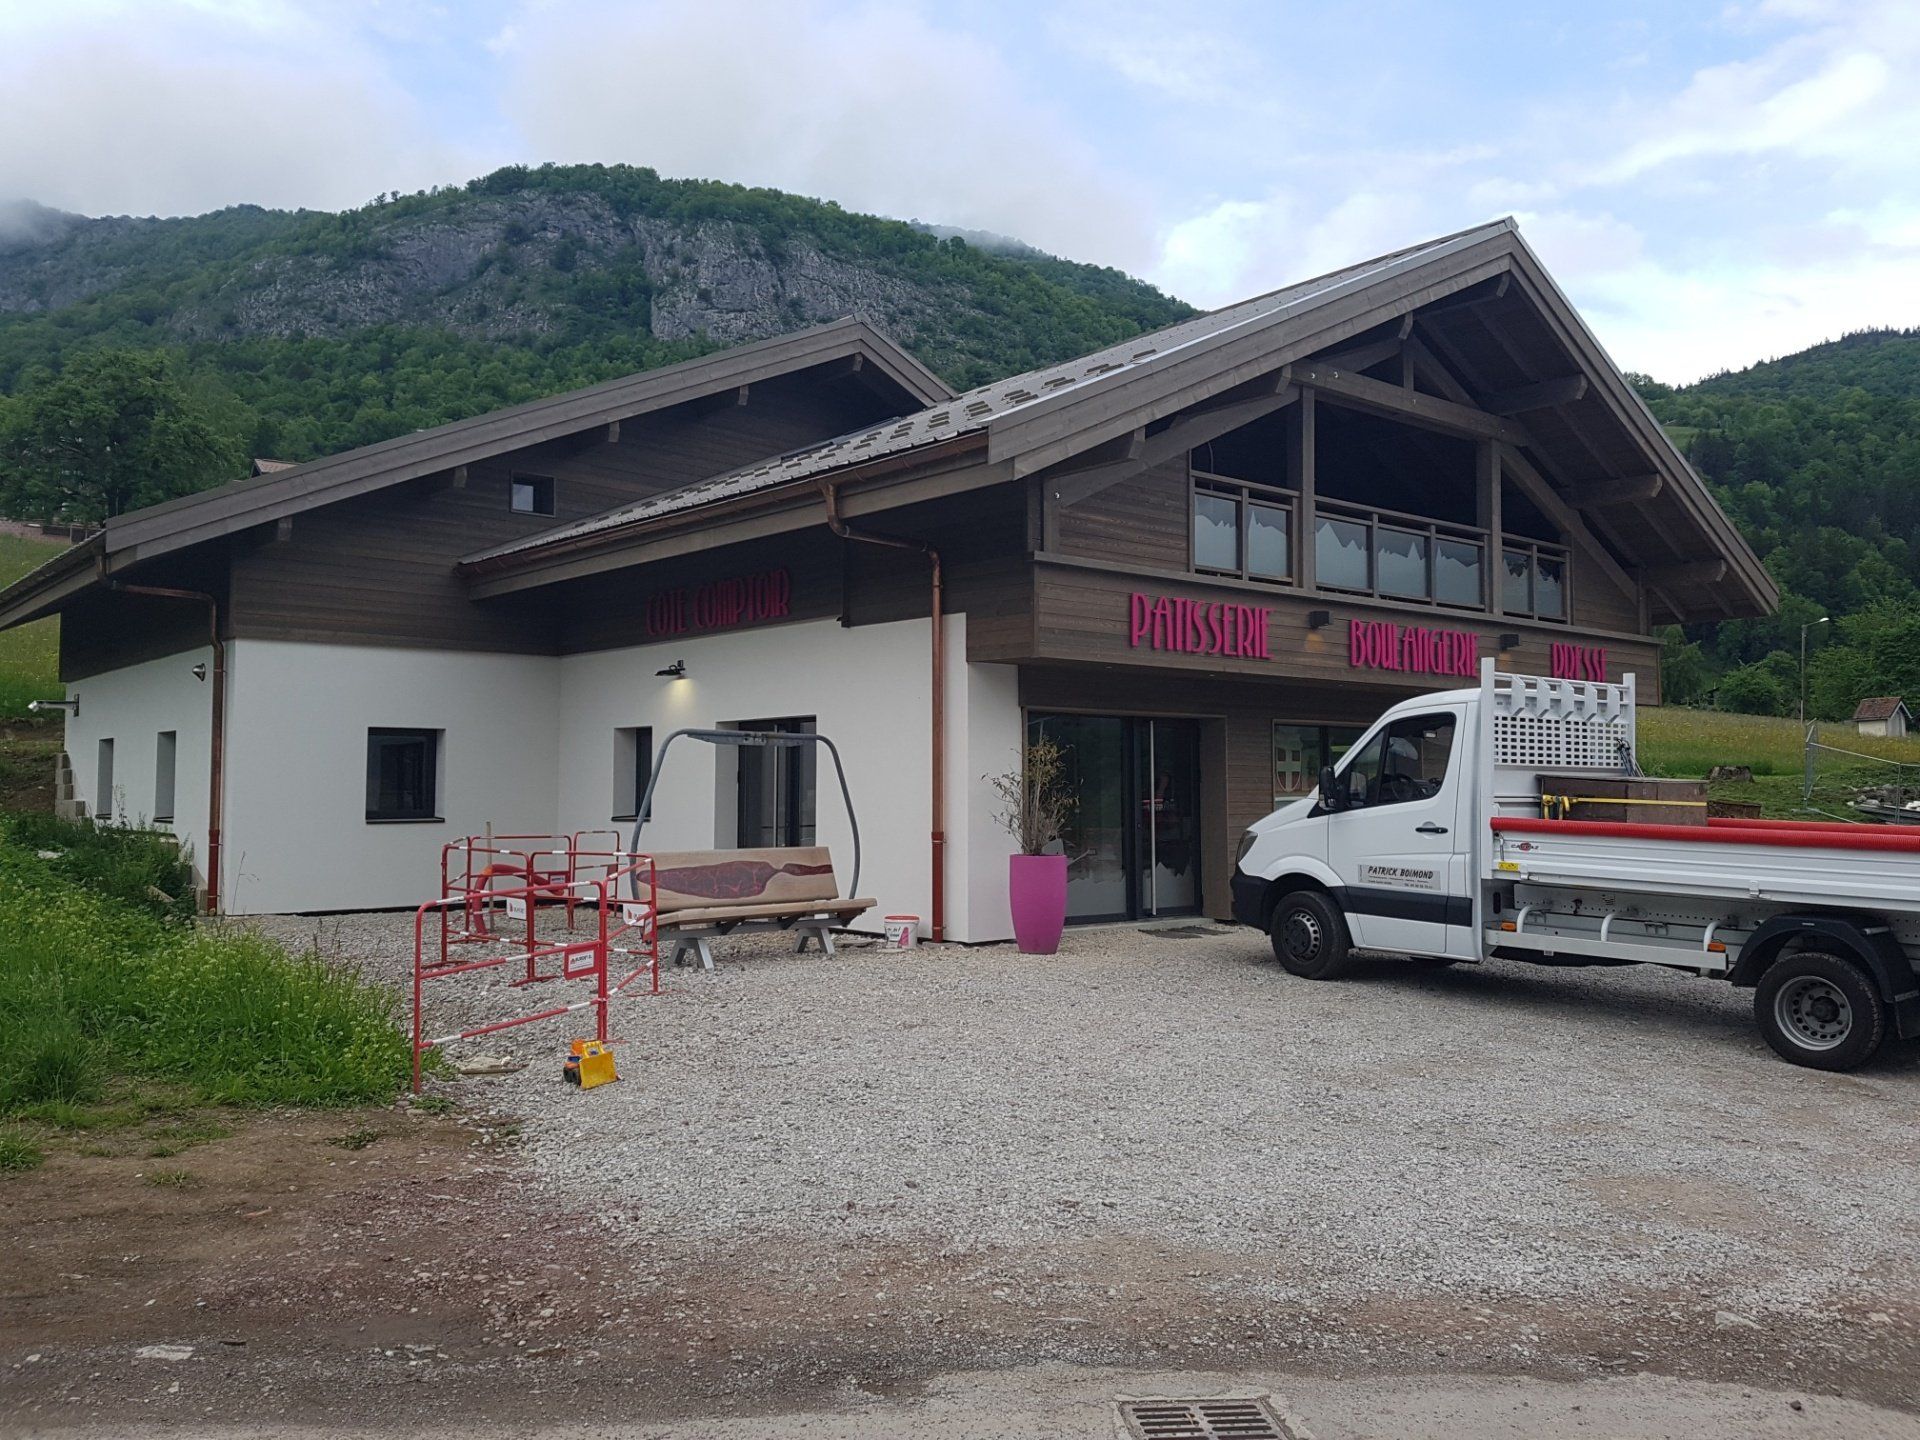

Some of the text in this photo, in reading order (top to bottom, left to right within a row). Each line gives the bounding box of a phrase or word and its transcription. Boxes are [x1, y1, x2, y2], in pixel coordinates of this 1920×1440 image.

[690, 567, 790, 629] COMPTOIR
[1130, 592, 1276, 660] PATISSERIE
[1350, 618, 1480, 679] BOULANGERIE
[1367, 865, 1398, 877] PATRICK
[1399, 868, 1434, 880] BOIMOND
